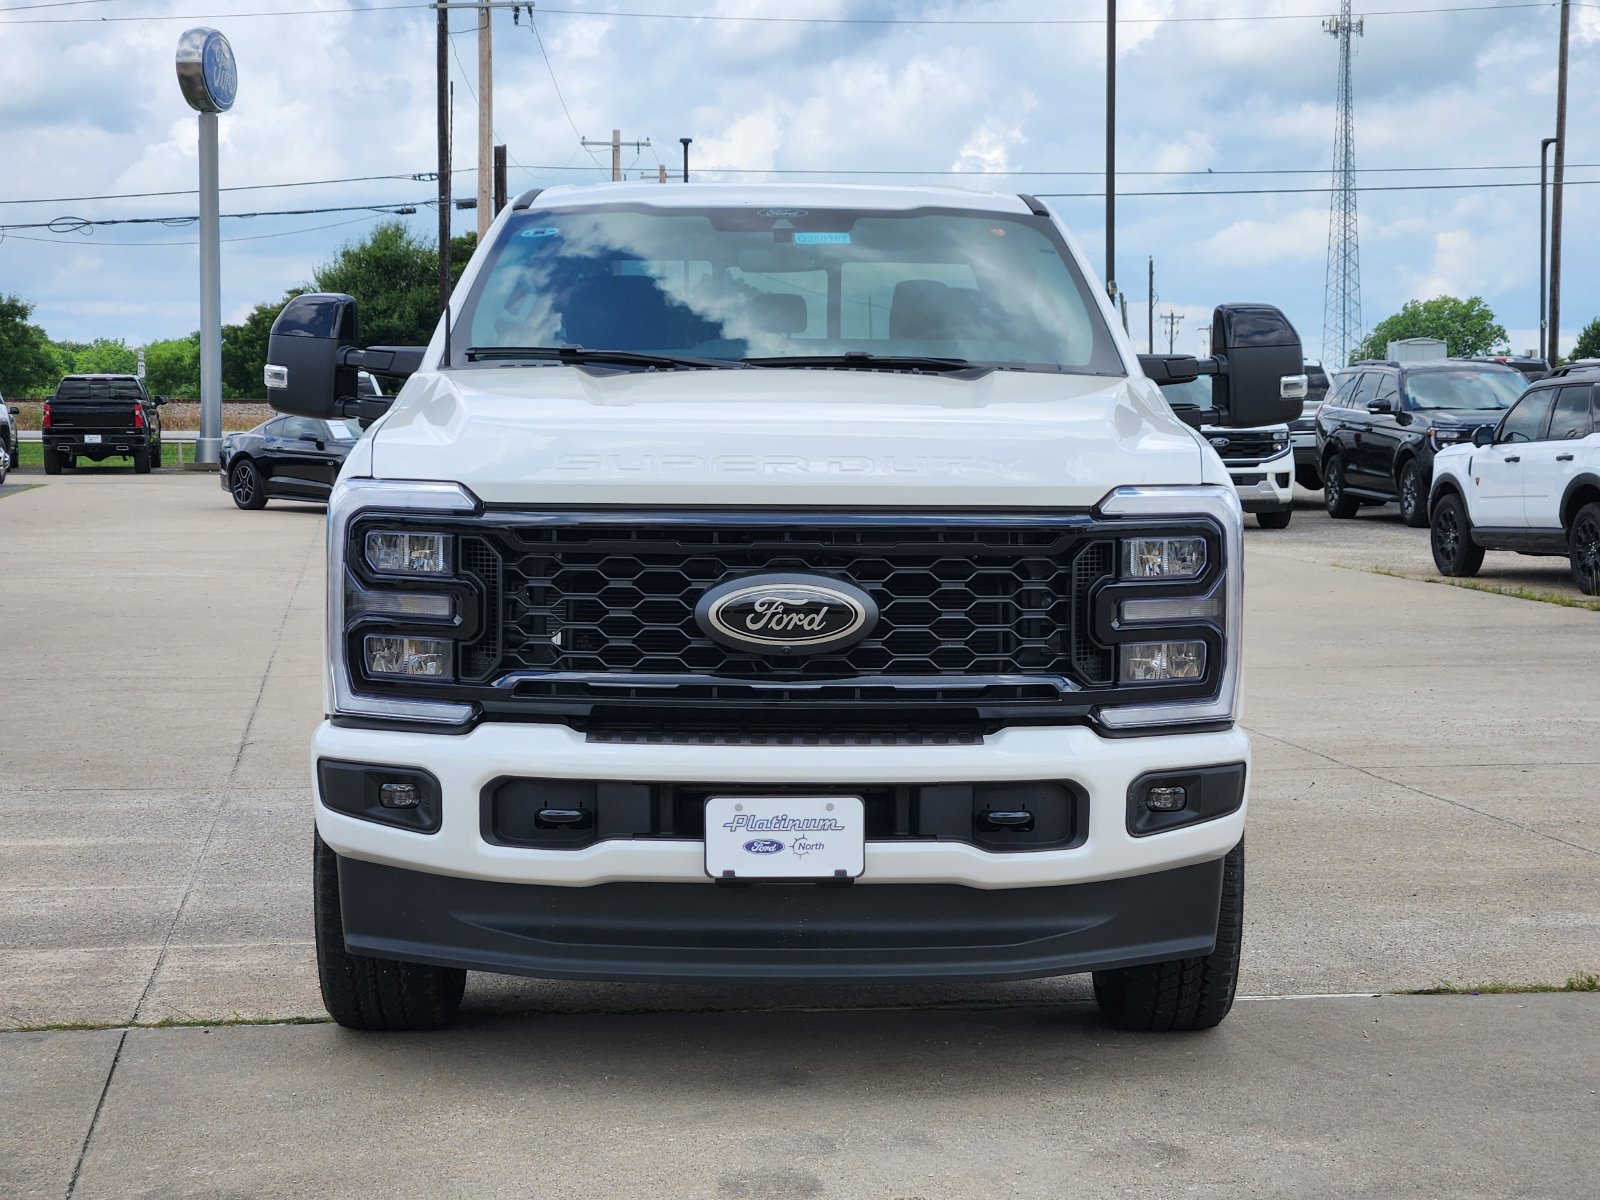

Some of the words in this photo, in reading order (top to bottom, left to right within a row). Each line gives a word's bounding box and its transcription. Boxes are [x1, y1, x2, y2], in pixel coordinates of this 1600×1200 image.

[555, 454, 810, 473] SUPER
[827, 455, 1024, 474] DUTY
[745, 596, 829, 631] Ford
[722, 814, 845, 833] Platinum
[751, 841, 777, 853] Ford
[798, 842, 825, 851] North
